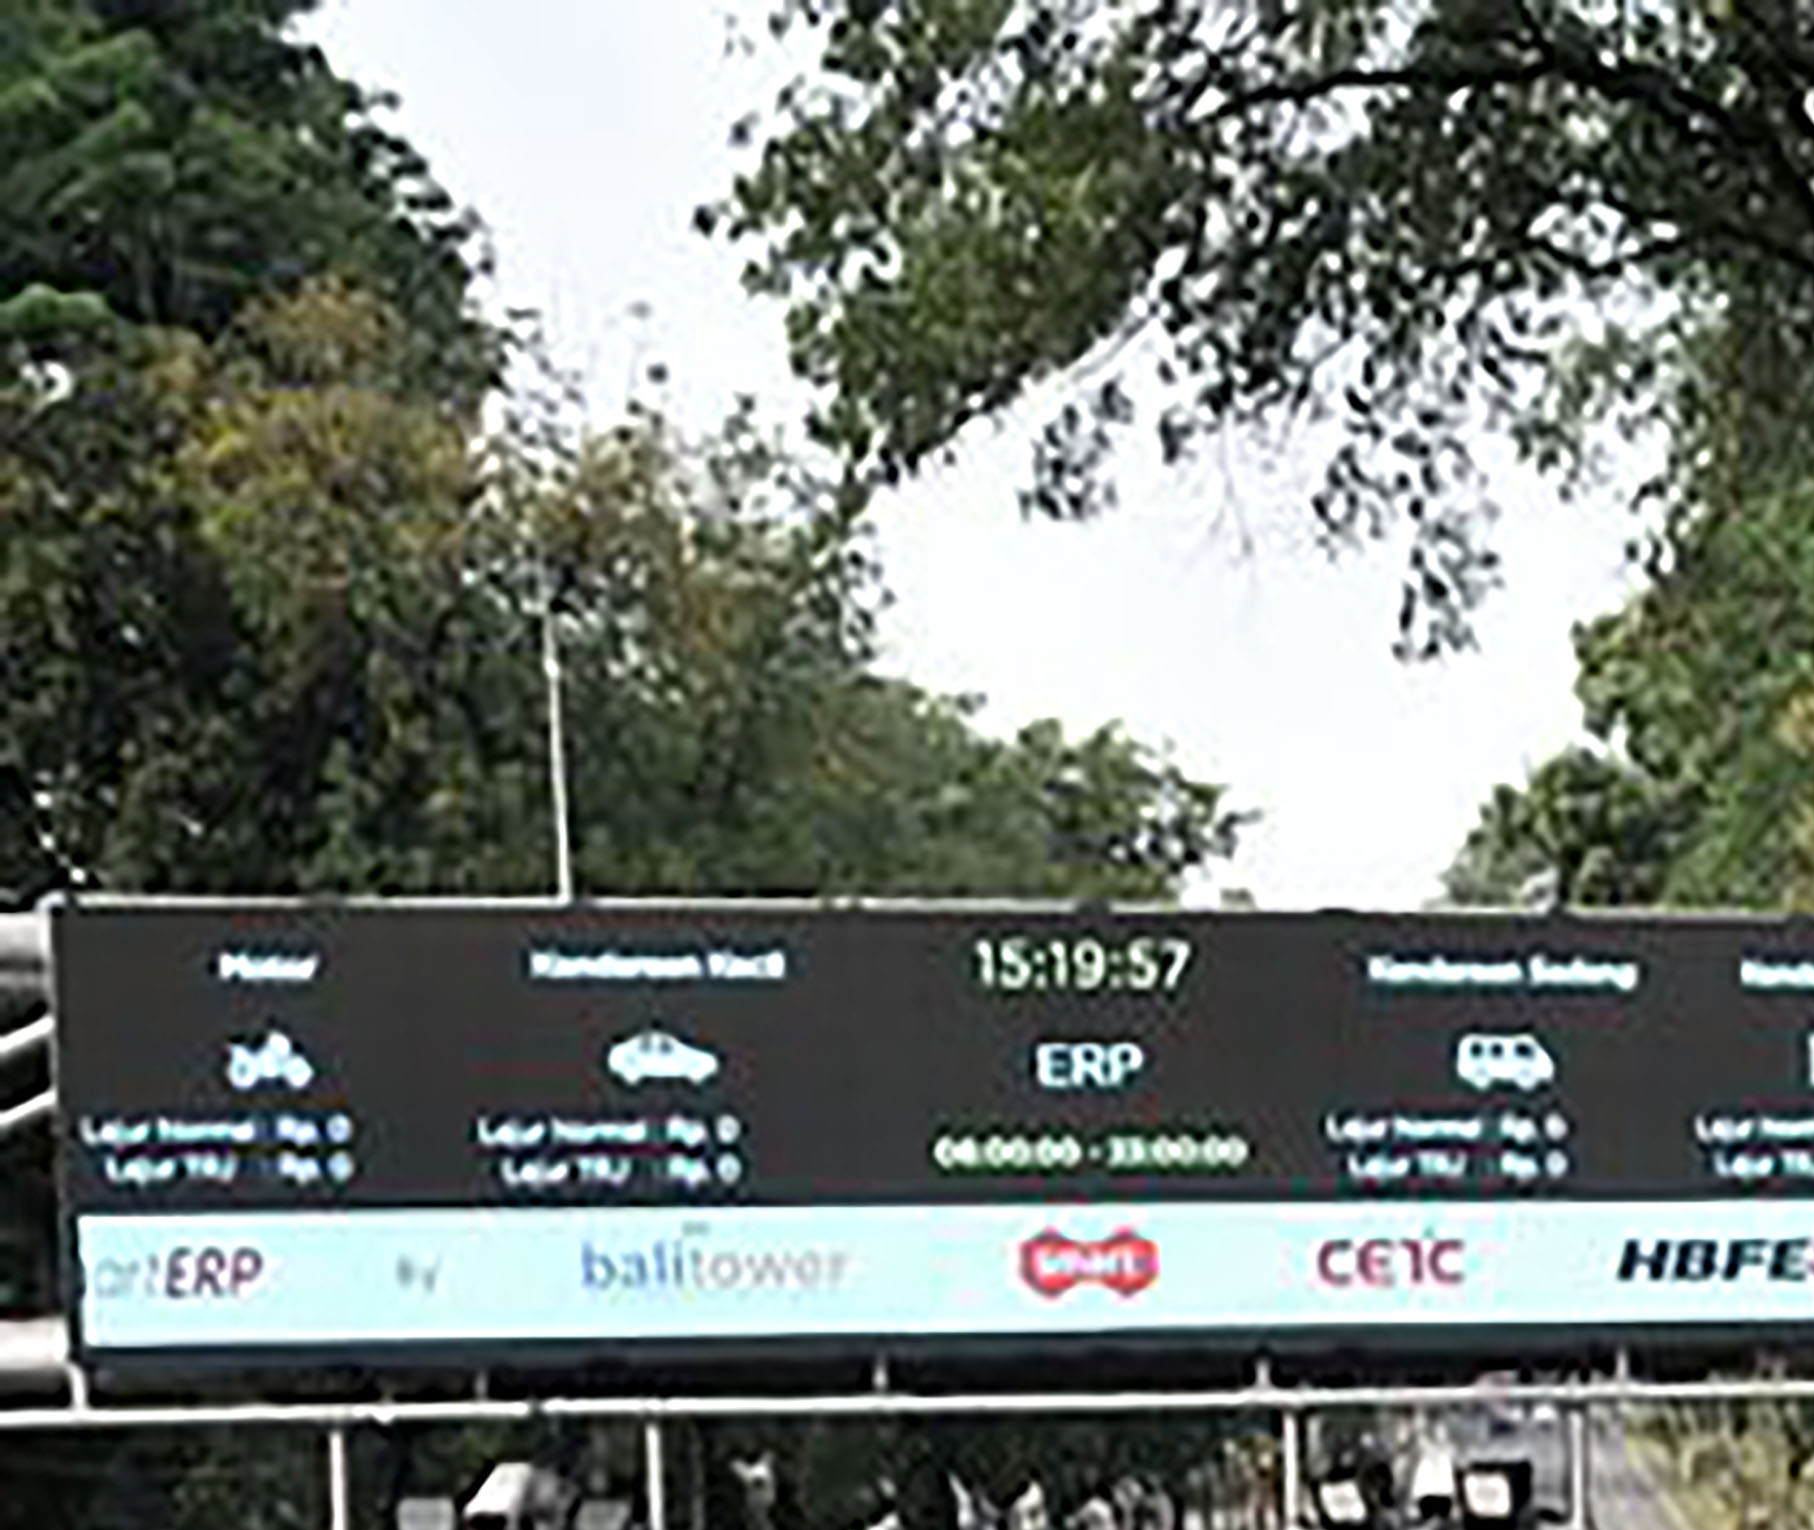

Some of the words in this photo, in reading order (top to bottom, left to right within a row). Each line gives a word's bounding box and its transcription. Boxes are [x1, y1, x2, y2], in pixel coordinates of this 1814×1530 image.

[975, 937, 1192, 989] 15:19:57
[1036, 1041, 1144, 1088] ERP
[581, 1239, 850, 1291] balitower
